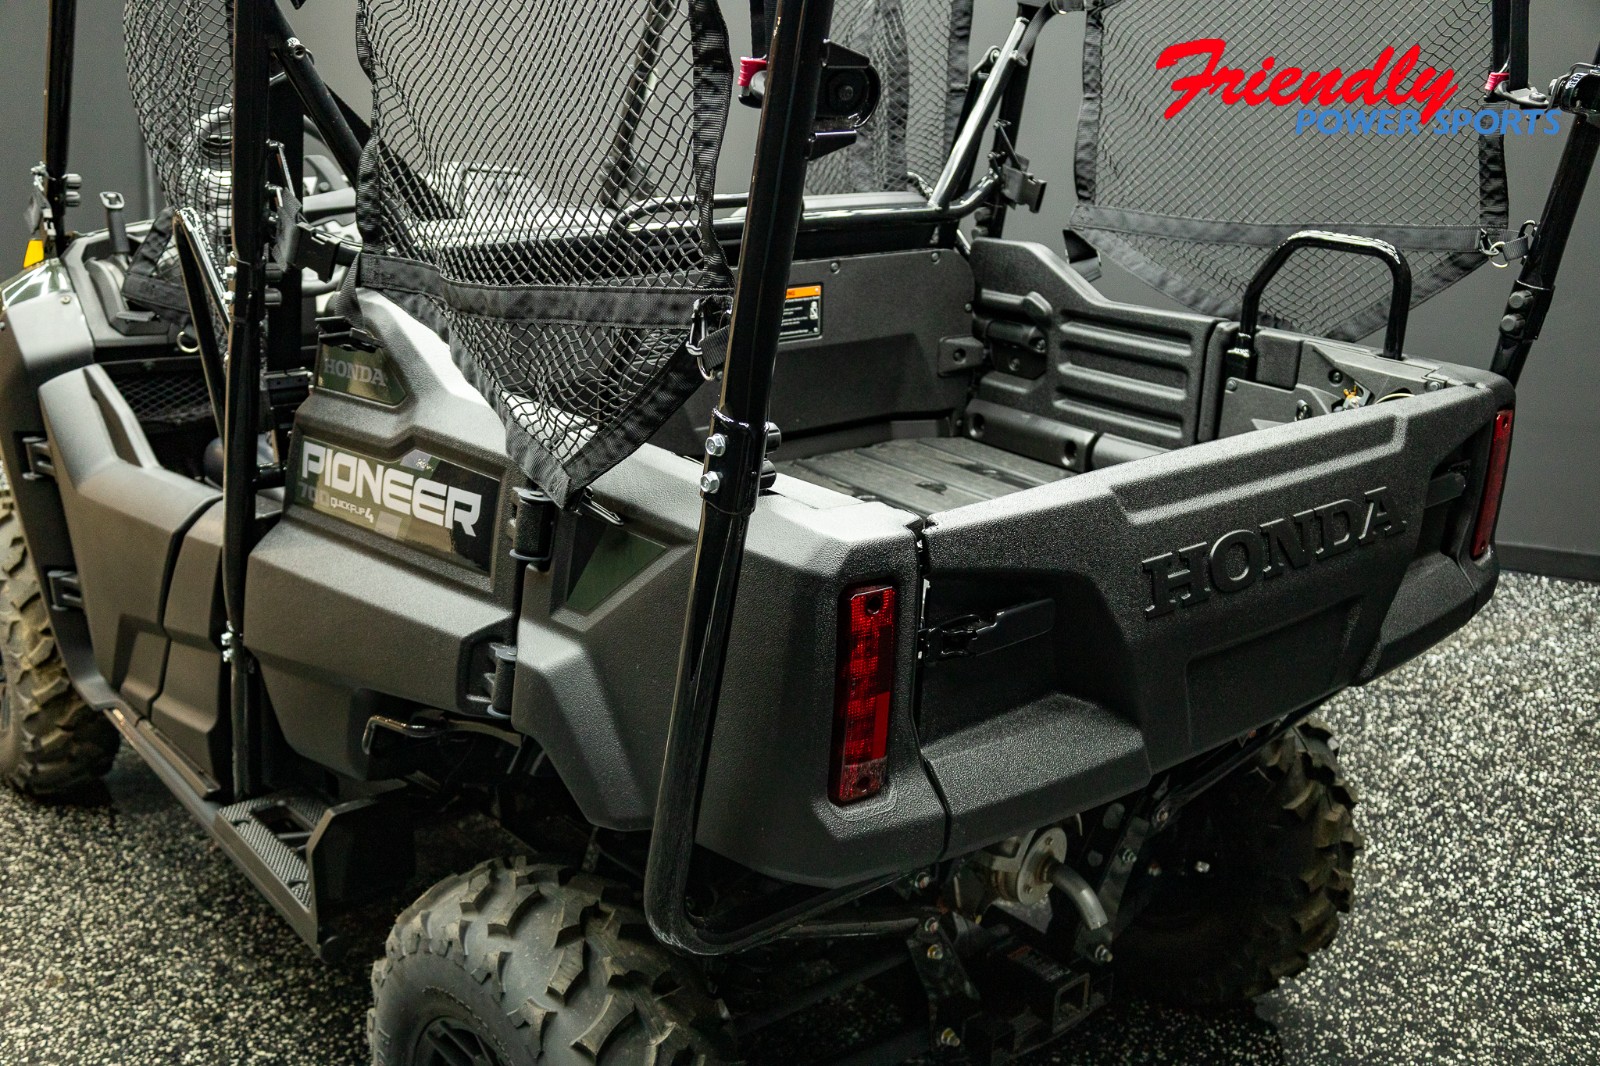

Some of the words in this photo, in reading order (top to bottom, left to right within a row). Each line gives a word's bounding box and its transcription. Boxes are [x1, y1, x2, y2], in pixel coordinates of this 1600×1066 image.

[323, 359, 387, 387] HONDA
[298, 481, 330, 507] 700
[302, 441, 482, 537] PIONEER
[1142, 486, 1407, 620] HONDA
